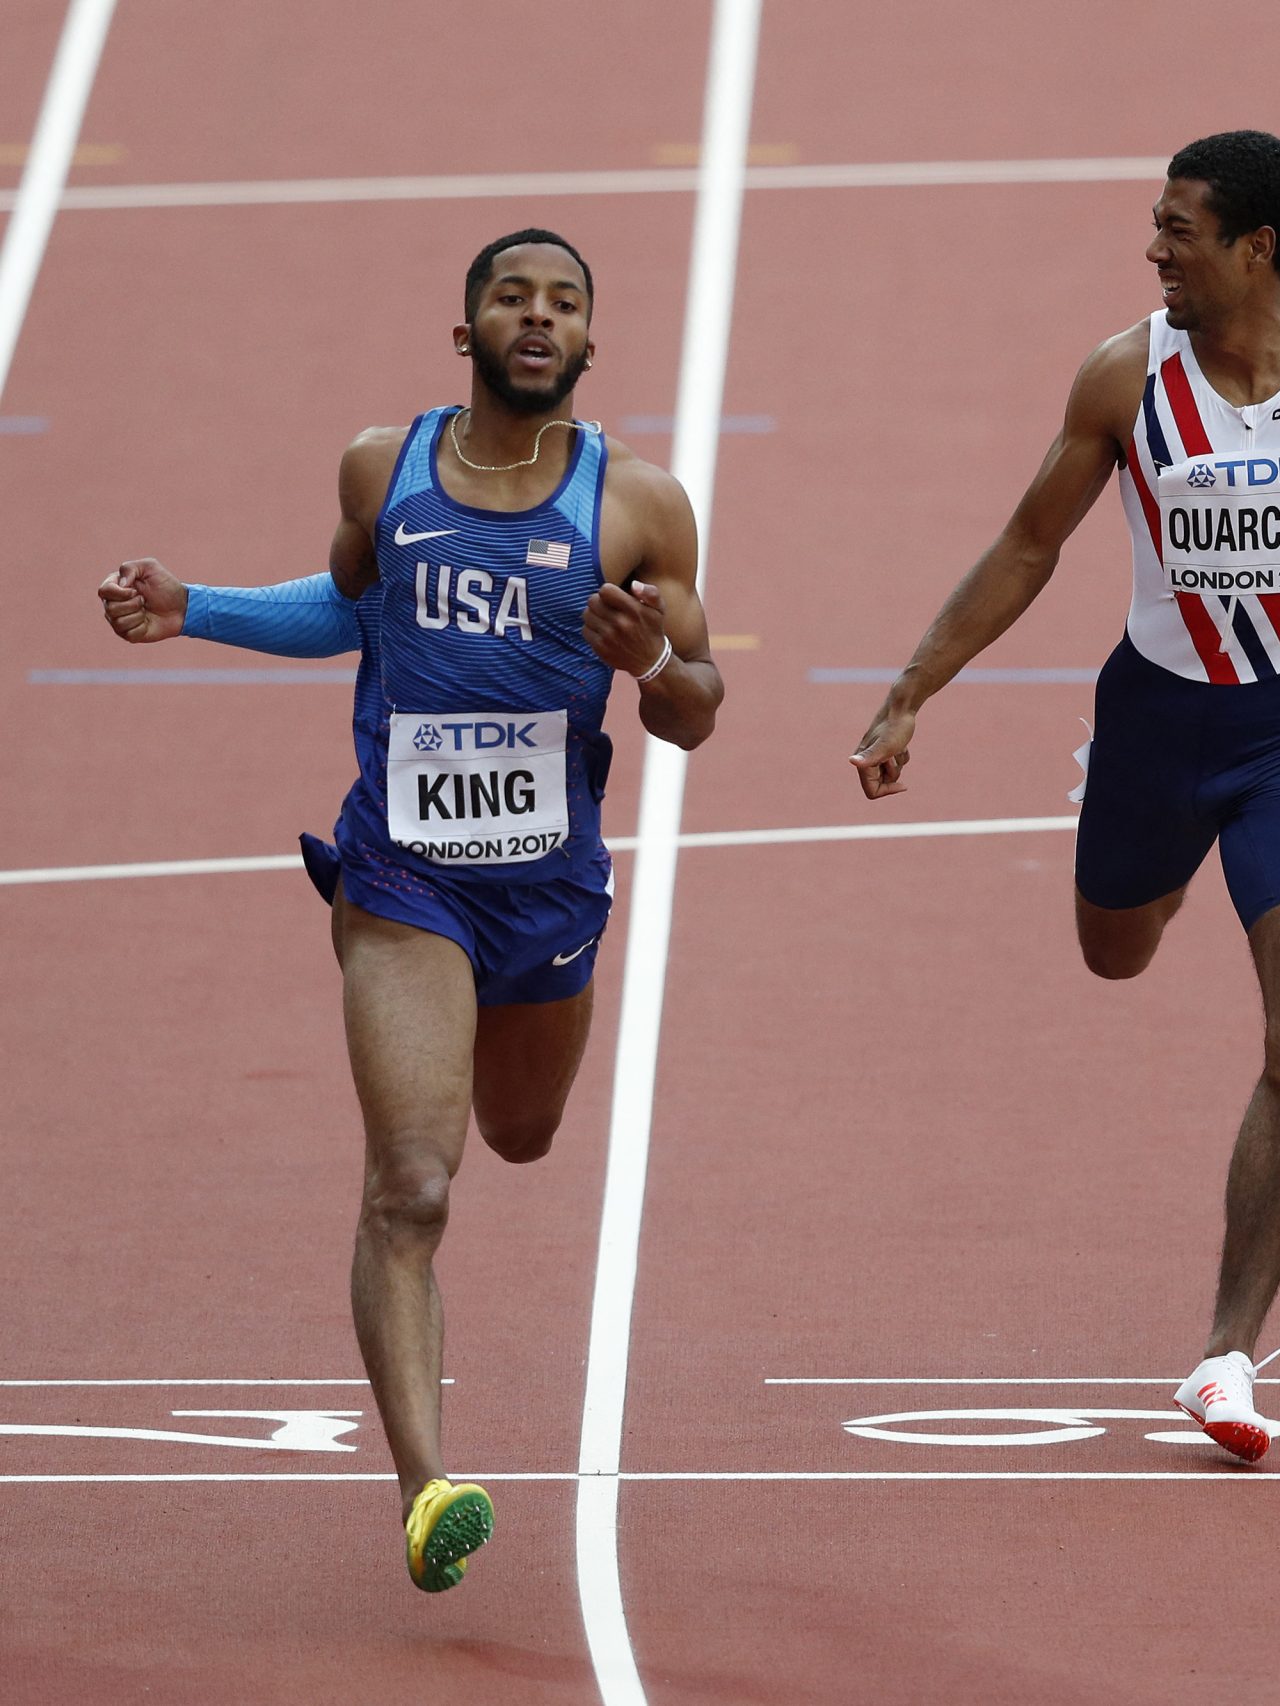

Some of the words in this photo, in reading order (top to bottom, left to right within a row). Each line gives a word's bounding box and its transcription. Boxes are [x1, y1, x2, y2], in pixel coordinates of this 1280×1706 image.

[1171, 569, 1274, 589] LONDON
[416, 562, 533, 641] USA
[441, 721, 538, 750] TDK
[417, 770, 536, 821] KING
[507, 832, 562, 857] 2017
